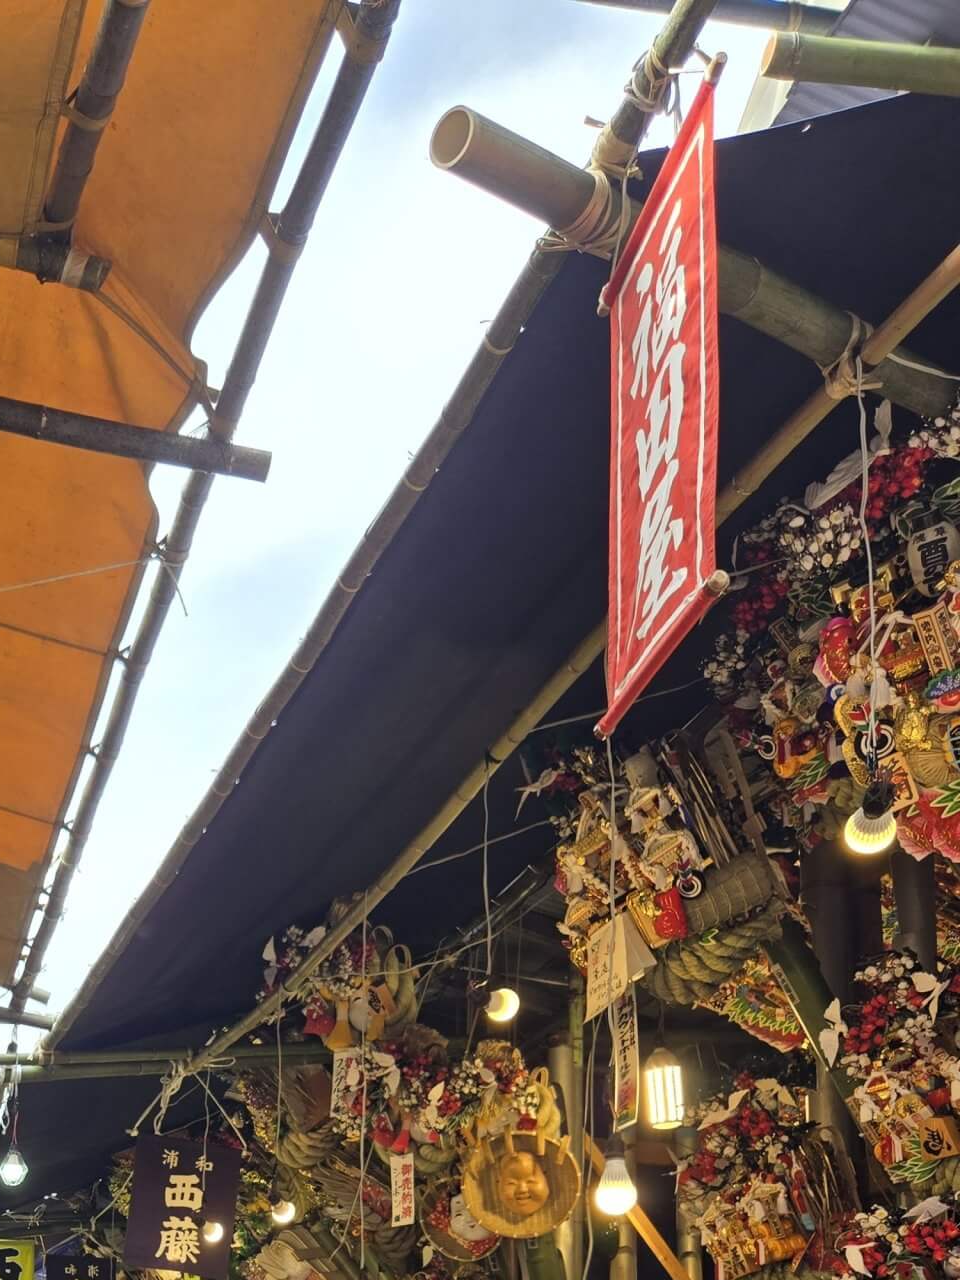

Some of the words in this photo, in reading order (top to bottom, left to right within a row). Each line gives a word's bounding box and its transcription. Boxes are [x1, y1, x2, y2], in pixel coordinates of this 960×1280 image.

[630, 199, 688, 639] 福田屋
[162, 1149, 214, 1172] 浦和
[155, 1173, 205, 1264] 西藤
